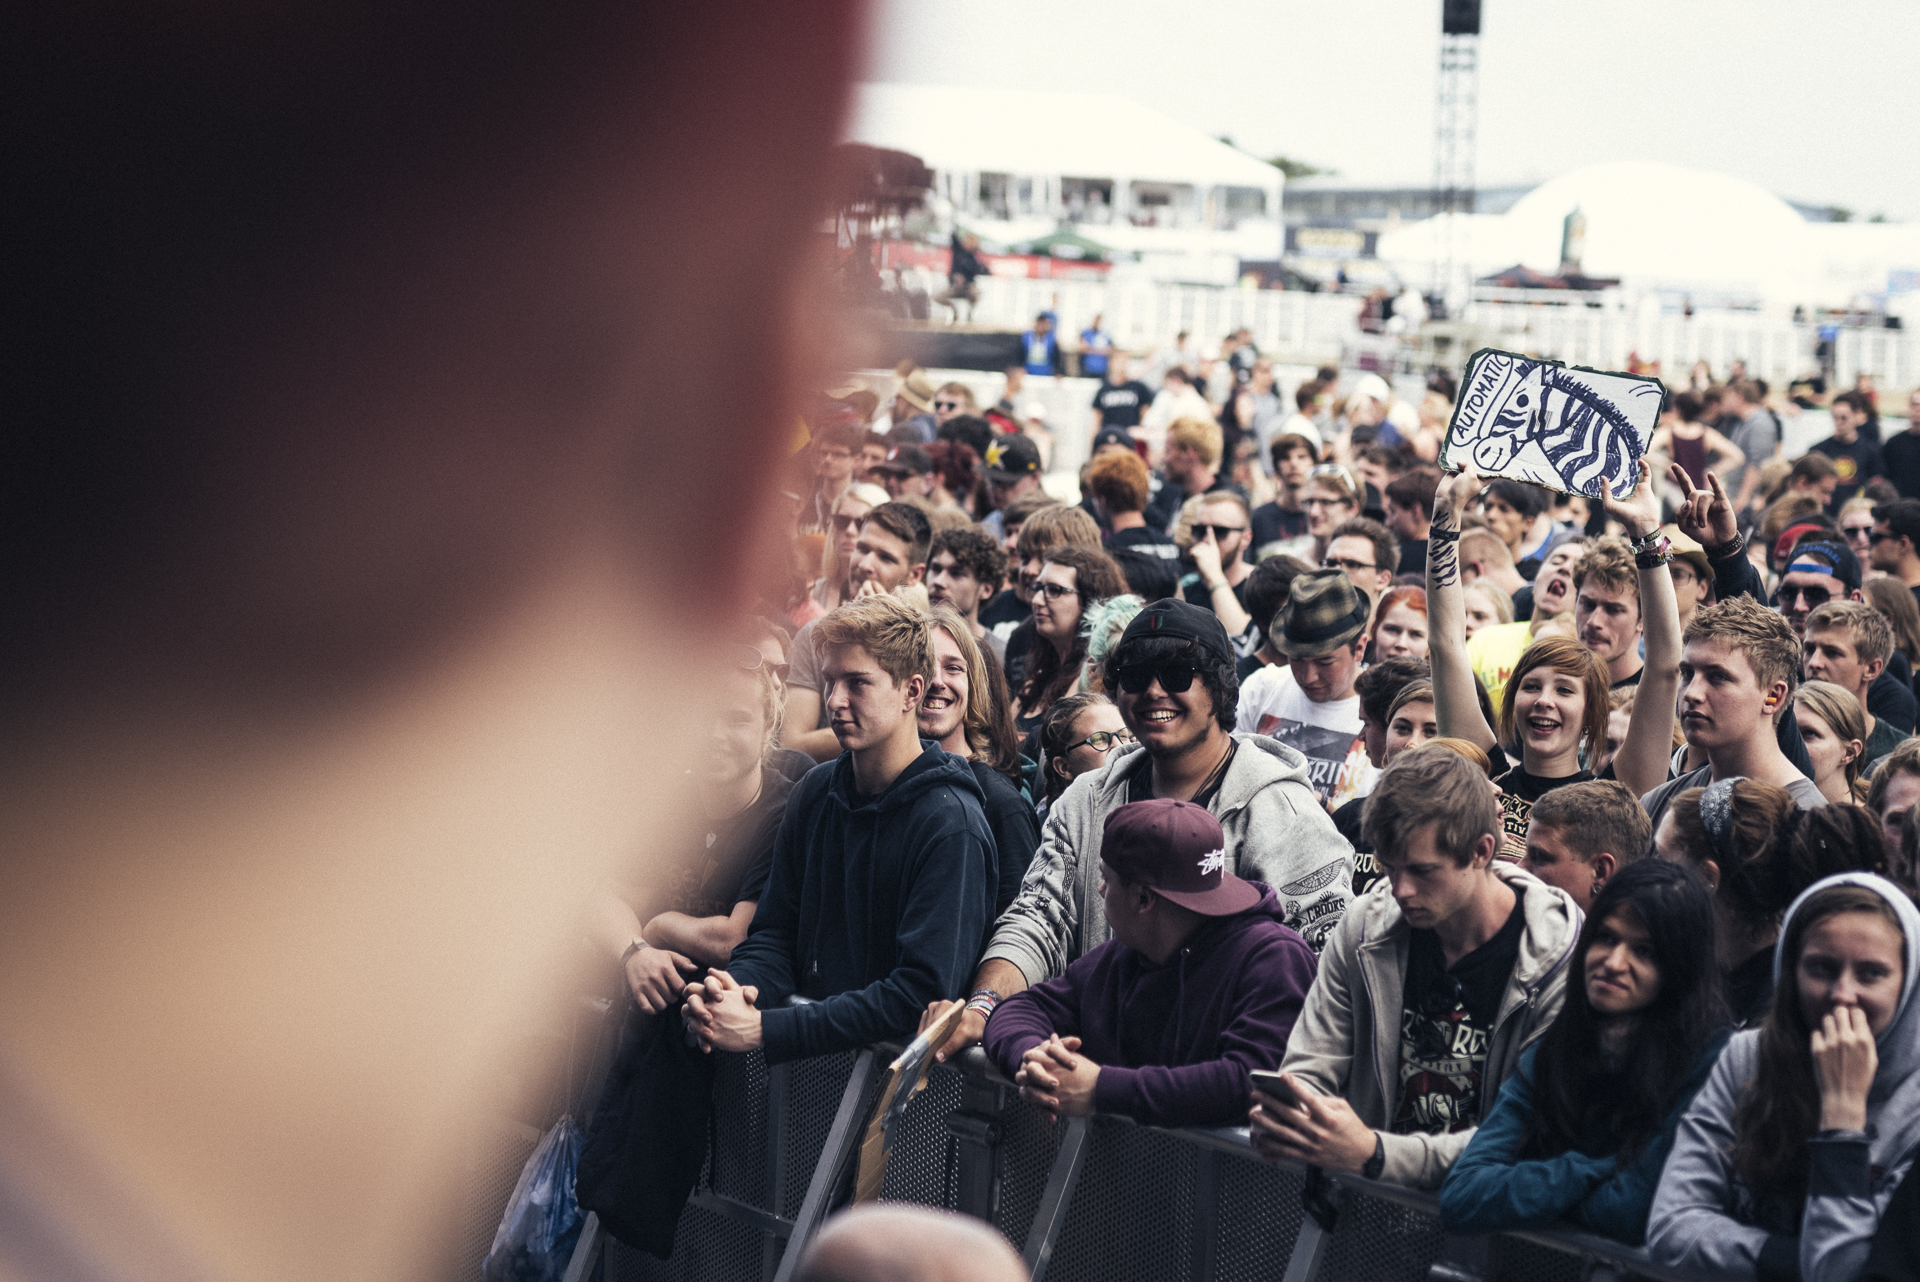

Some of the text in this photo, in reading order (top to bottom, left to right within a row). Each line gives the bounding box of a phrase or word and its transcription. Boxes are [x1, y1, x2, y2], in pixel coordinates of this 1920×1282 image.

[1457, 354, 1510, 439] AUTOMATIC
[1502, 797, 1527, 817] OCK
[1504, 821, 1529, 836] TIV
[1306, 897, 1346, 924] CROOKS
